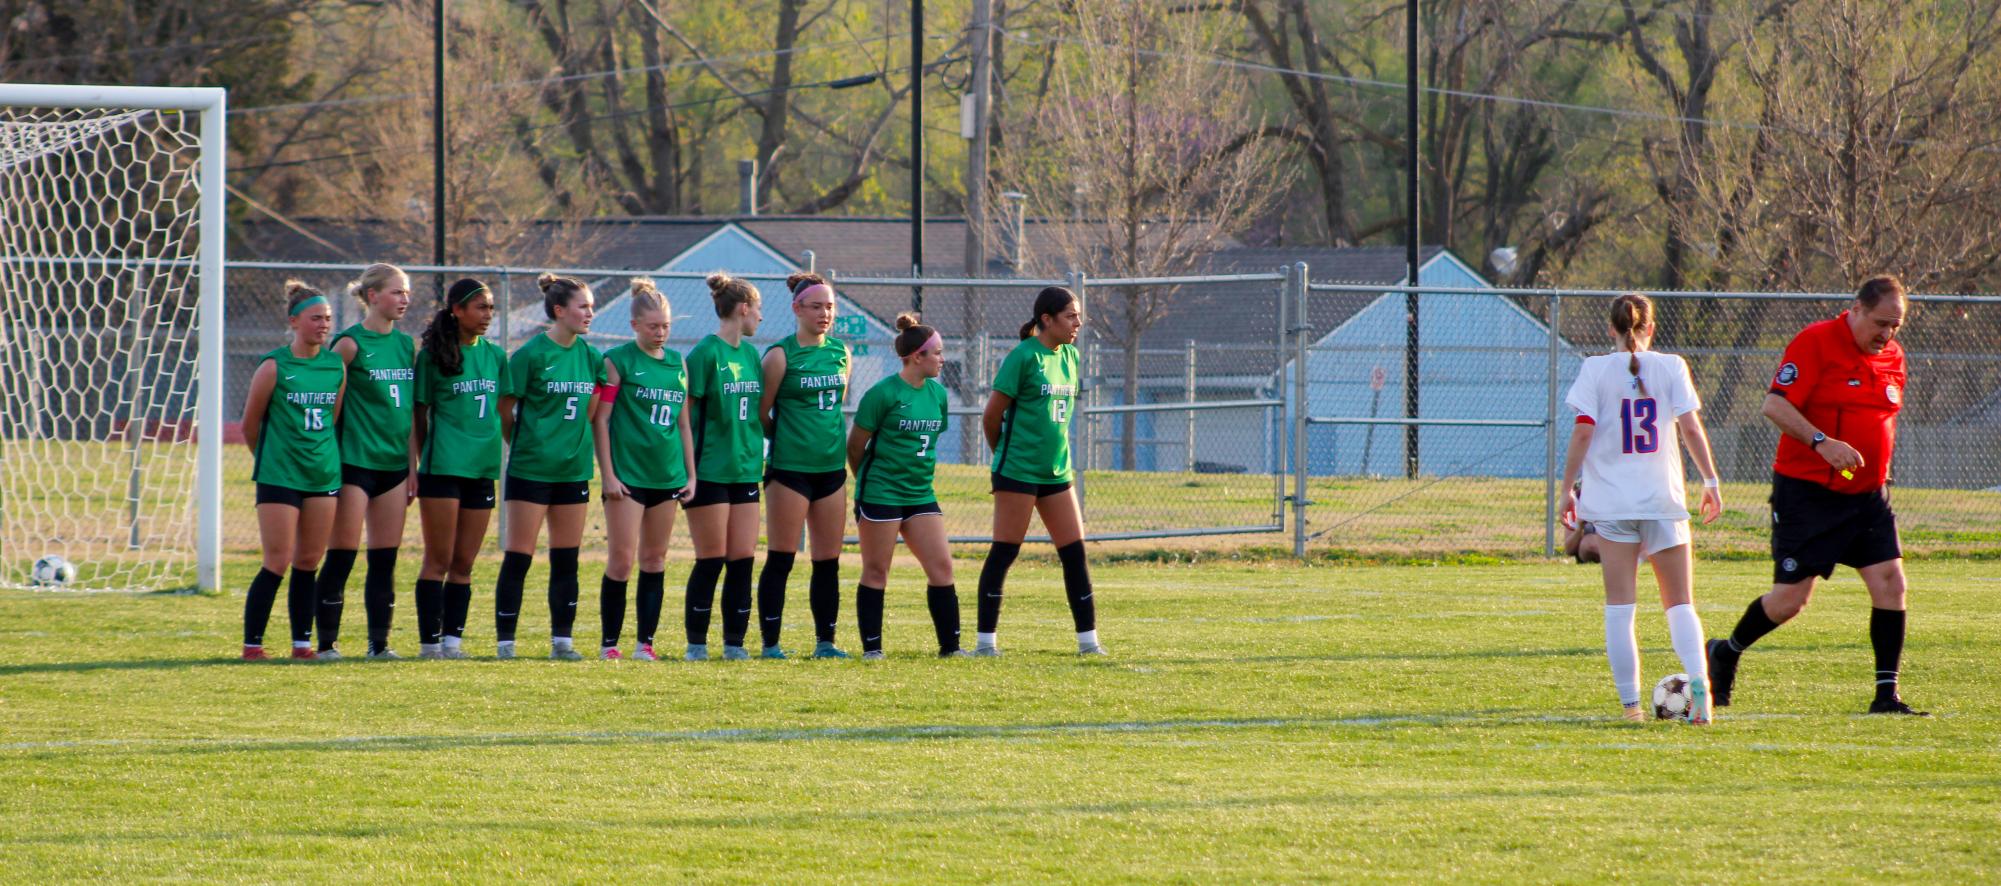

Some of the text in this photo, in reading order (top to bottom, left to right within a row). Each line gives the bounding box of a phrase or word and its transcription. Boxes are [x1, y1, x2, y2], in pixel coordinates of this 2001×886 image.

[369, 368, 415, 381] PANTHERS
[286, 391, 338, 406] PANTHERS
[389, 384, 401, 408] 9
[547, 381, 595, 395] PANTHERS
[635, 386, 684, 404] PANTHERS
[817, 389, 837, 411] 13
[474, 394, 487, 419] 7
[563, 396, 579, 421] 5
[649, 403, 671, 427] 10
[740, 396, 749, 421] 8
[1052, 399, 1067, 423] 12
[1620, 397, 1659, 454] 13
[916, 434, 931, 457] 3
